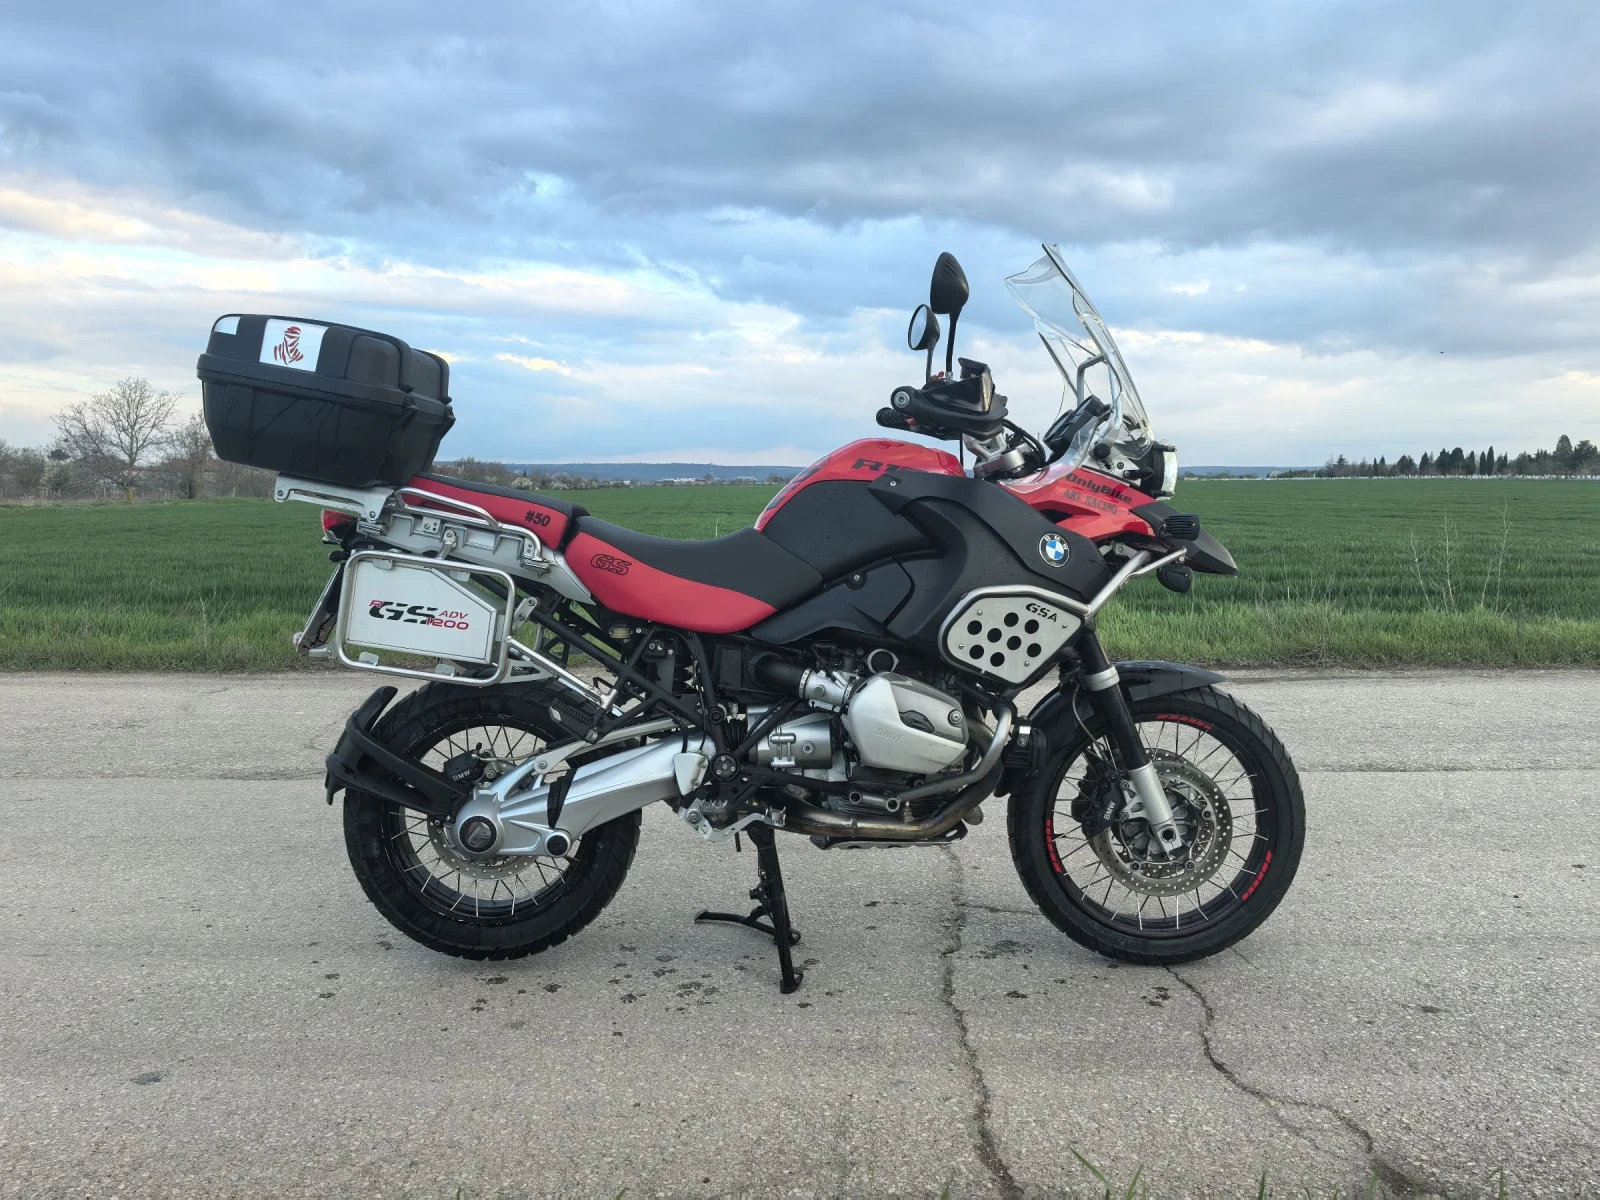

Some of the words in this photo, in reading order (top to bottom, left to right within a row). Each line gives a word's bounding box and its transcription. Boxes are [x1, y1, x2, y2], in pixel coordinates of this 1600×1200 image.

[1066, 474, 1132, 503] OnlyBike
[1084, 494, 1118, 515] RACING
[525, 510, 551, 527] #50
[1044, 535, 1069, 550] BMW
[590, 553, 632, 576] GS
[368, 601, 438, 624] GS
[438, 610, 469, 619] ADV
[1025, 603, 1057, 622] GSA
[425, 616, 469, 630] 1200
[876, 728, 902, 742] BMW
[452, 770, 469, 781] BMW
[1103, 801, 1116, 820] BMW
